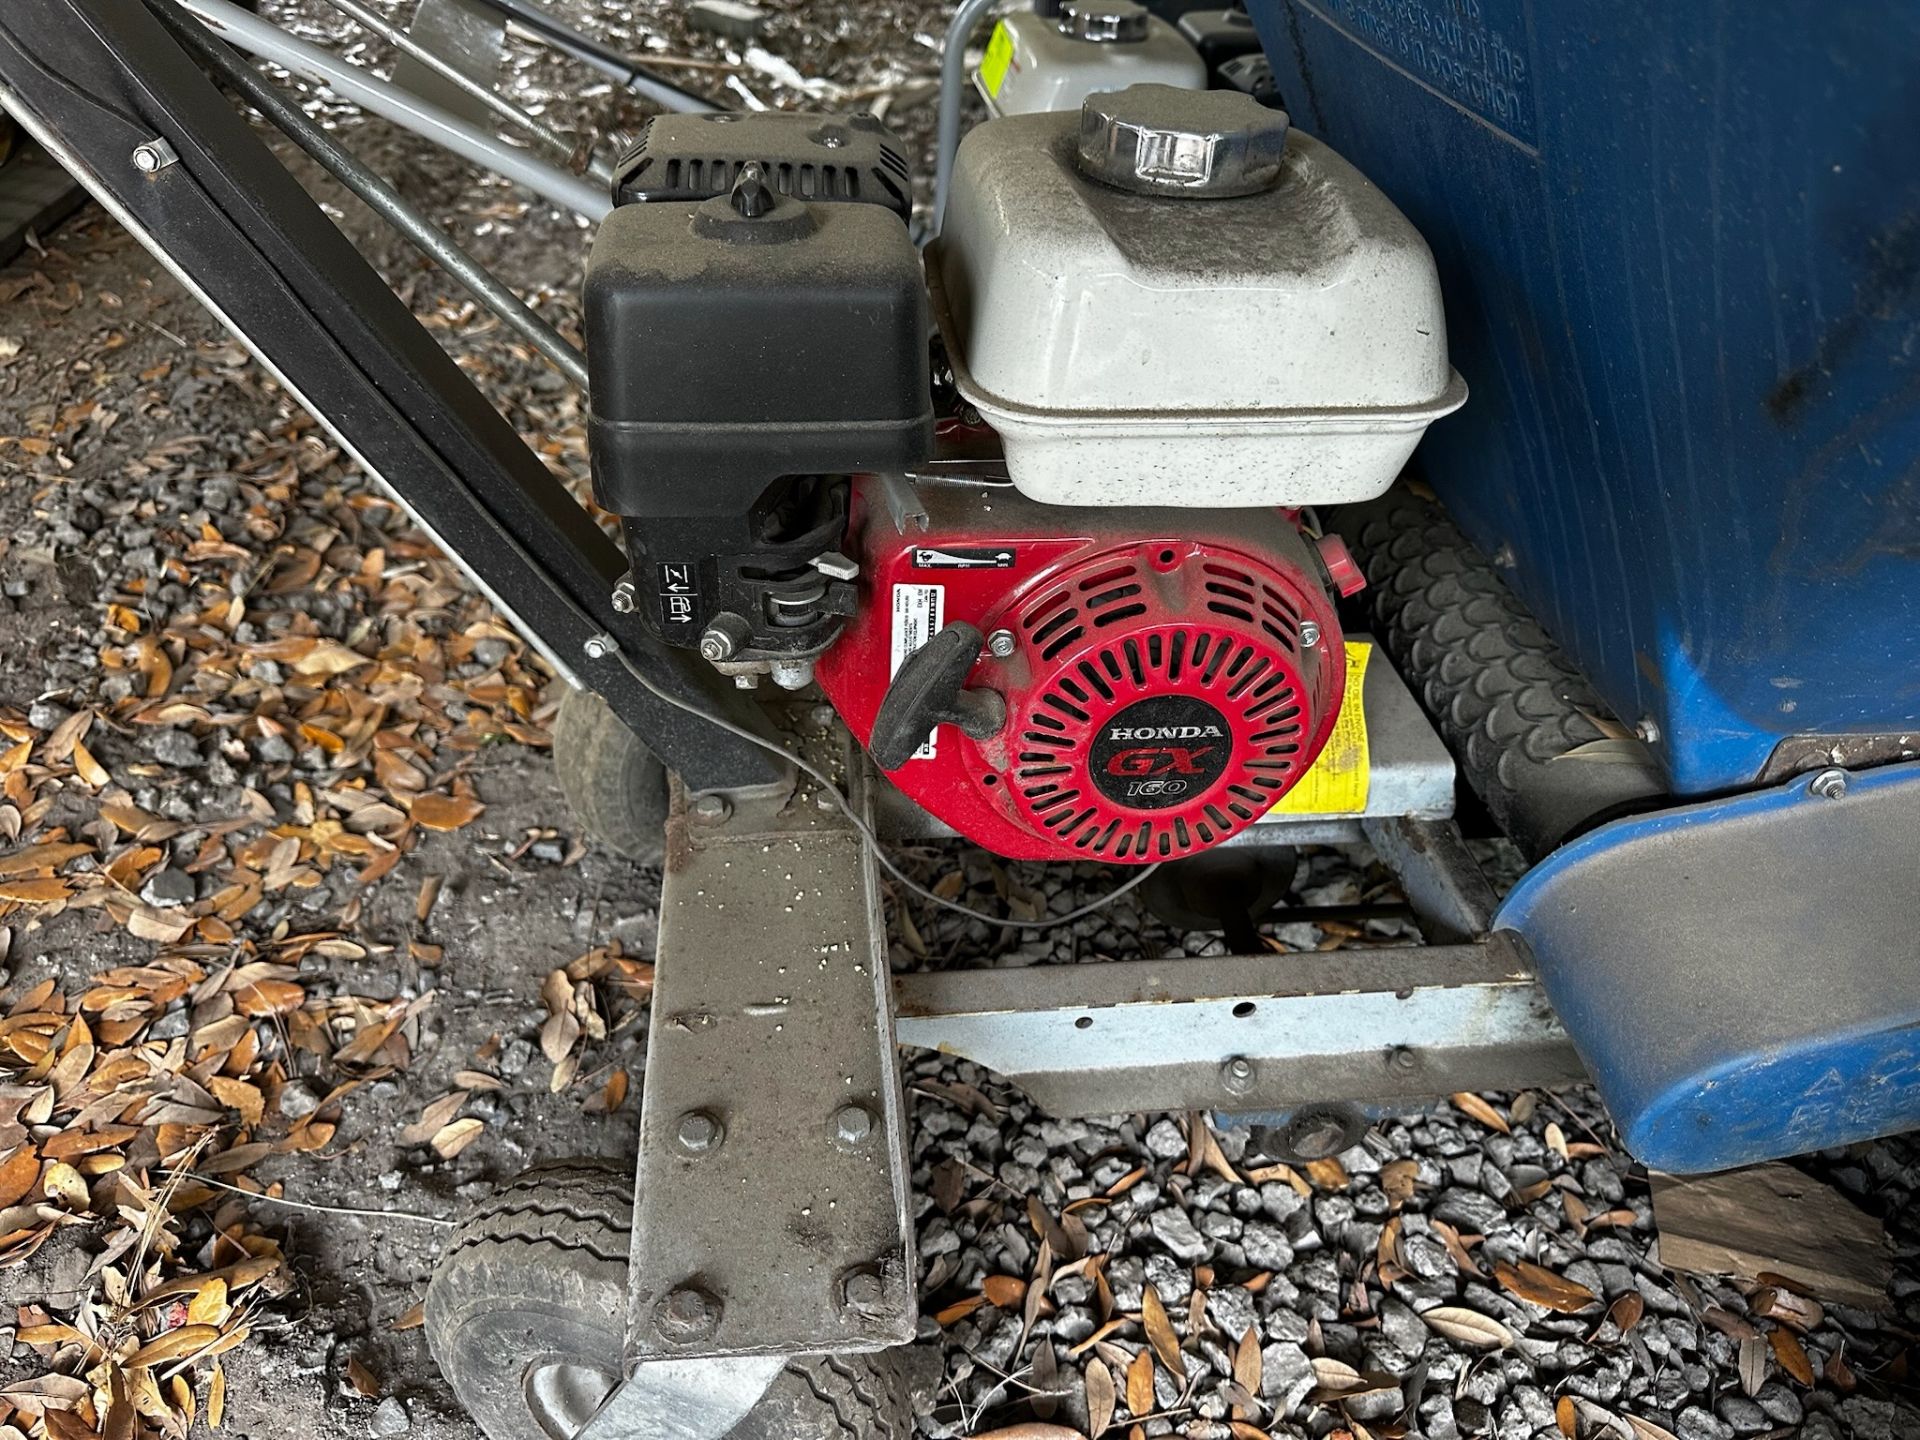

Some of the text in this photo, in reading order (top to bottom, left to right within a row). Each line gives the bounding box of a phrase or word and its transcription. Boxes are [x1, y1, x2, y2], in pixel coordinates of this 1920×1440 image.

[1434, 13, 1464, 54] out
[1109, 725, 1224, 740] HONDA
[1106, 743, 1216, 777] GX
[1126, 779, 1188, 797] 160
